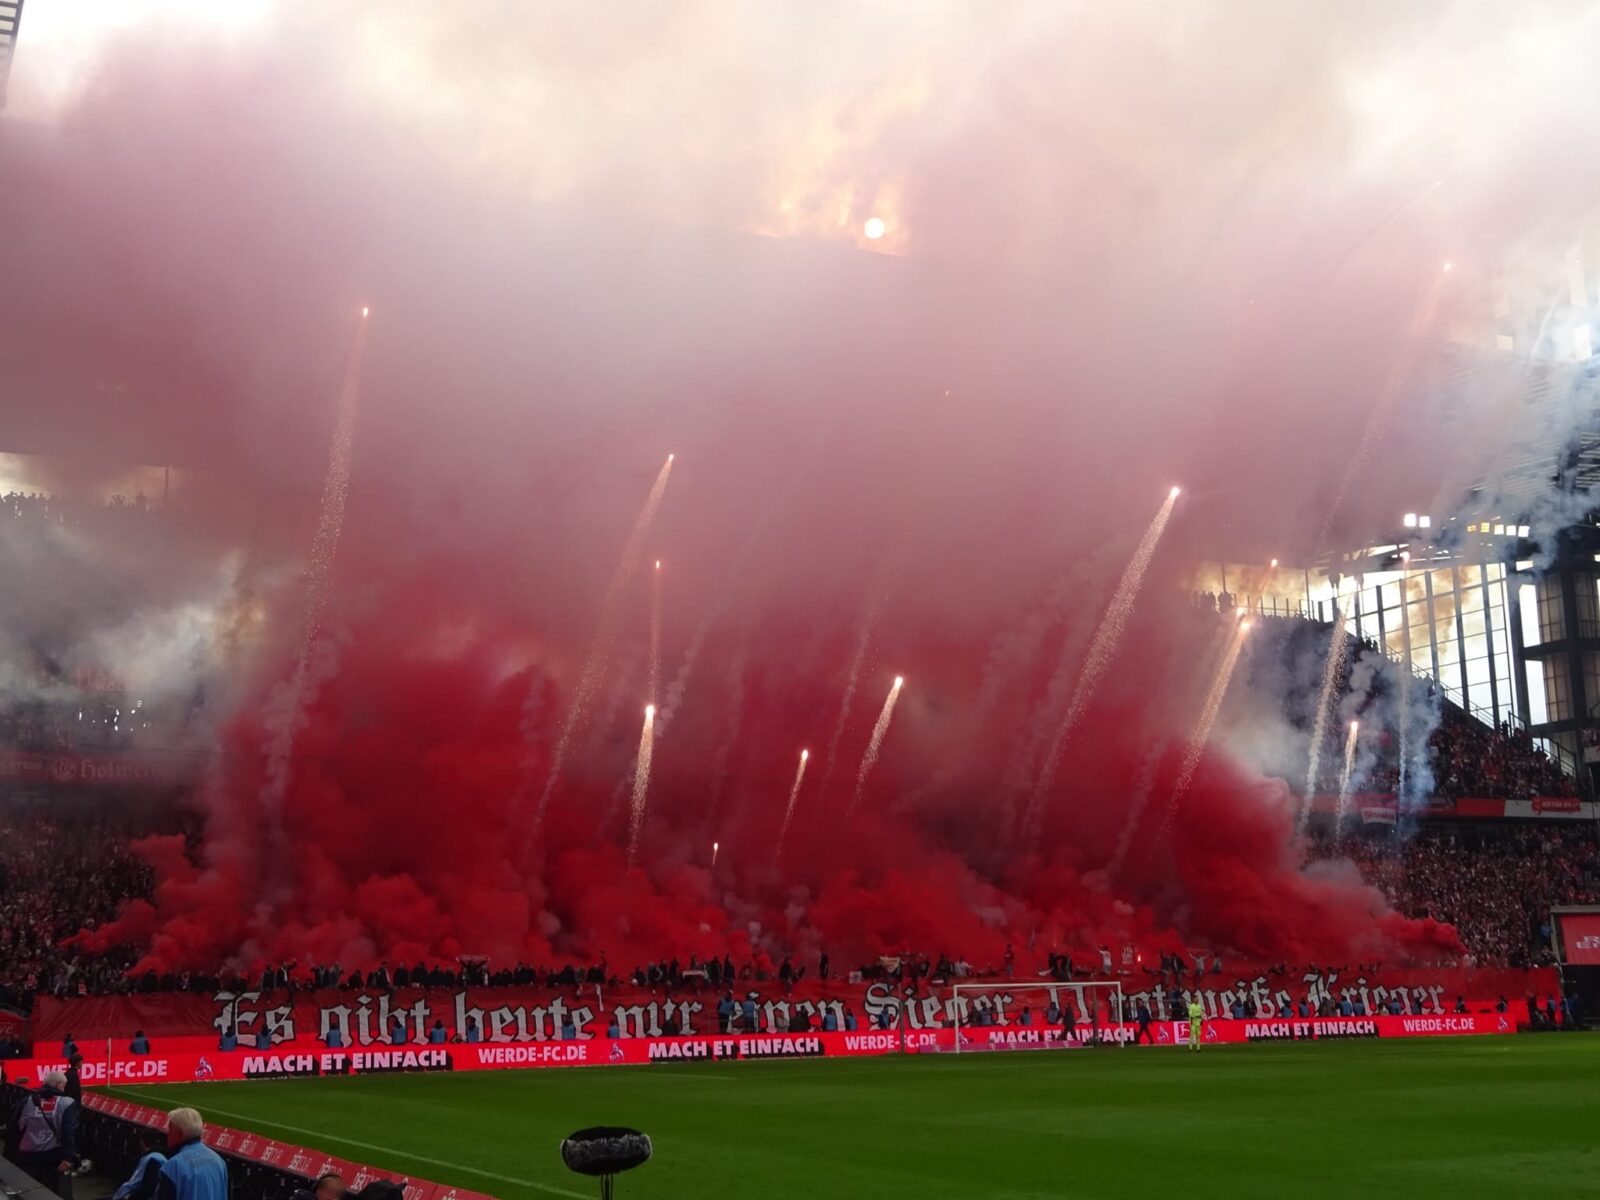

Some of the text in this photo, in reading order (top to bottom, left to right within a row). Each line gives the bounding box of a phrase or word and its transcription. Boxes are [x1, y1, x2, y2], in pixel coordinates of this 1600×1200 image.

[213, 991, 294, 1046] Es
[320, 994, 431, 1047] gibt
[453, 991, 595, 1043] heute
[614, 998, 702, 1038] nur
[1303, 973, 1444, 1017] Krieger
[1245, 1020, 1375, 1037] MACH ET EINFACH
[1403, 1018, 1475, 1032] WERDE-FC.DE
[845, 1033, 937, 1050] WERDE-C.DE
[989, 1030, 1039, 1043] MACH
[478, 1045, 587, 1064] WERDE-FC.DE
[648, 1037, 819, 1059] MACH ET EINFACH
[37, 1060, 168, 1082] WEDE-FC.DE
[242, 1050, 447, 1074] MACH ET EINFACH
